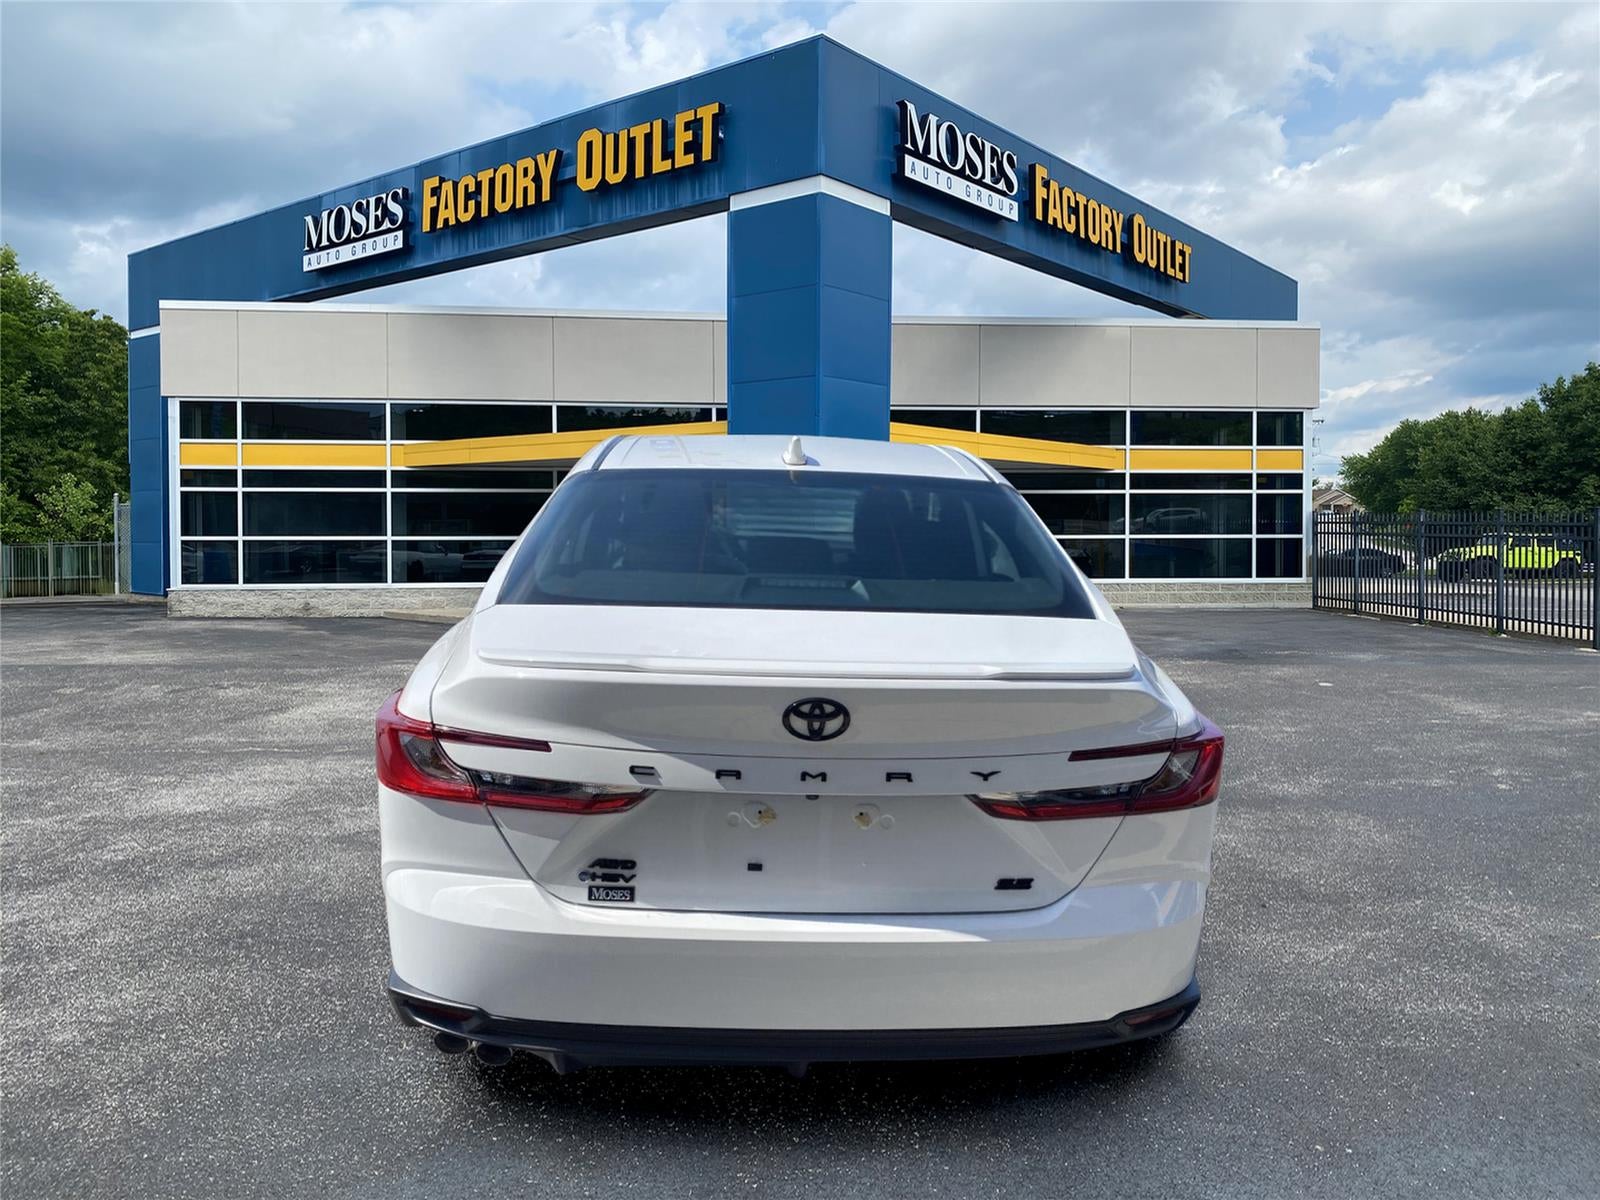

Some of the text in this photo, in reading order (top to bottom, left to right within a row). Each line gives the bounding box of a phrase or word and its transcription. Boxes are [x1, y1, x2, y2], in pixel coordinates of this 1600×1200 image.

[422, 102, 720, 233] FACTORY OUTLET
[904, 100, 1018, 195] MOSES
[910, 161, 1015, 215] AUTO GROUP
[303, 187, 404, 251] MOSES
[1034, 163, 1192, 283] FACTORY OUTLET
[307, 234, 399, 268] AUTO GROUP
[629, 765, 1001, 783] CAMRY
[592, 887, 630, 900] MOSES
